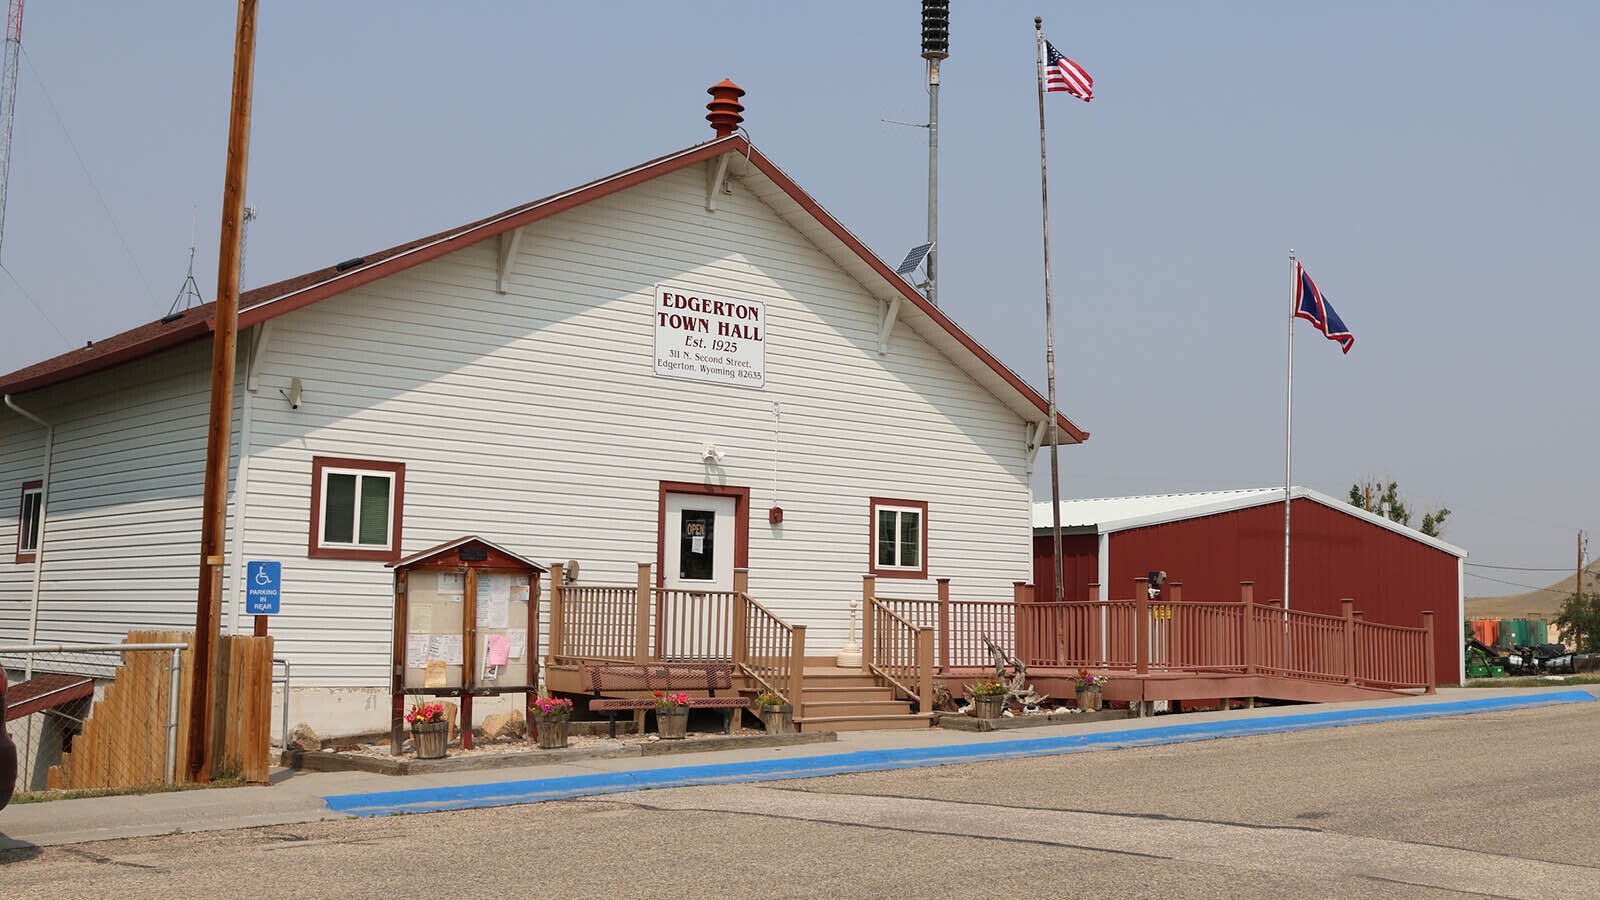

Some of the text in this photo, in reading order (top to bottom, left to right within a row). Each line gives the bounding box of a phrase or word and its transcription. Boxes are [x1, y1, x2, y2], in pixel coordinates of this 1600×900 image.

[663, 292, 759, 321] EDGERTON
[658, 312, 762, 341] TOWN HALL
[685, 336, 737, 352] Est. 1925
[669, 350, 680, 358] 311
[684, 352, 692, 360] N.
[695, 353, 722, 364] Second
[700, 365, 735, 378] Wyoming
[738, 370, 762, 380] 82635
[687, 524, 704, 535] OPEN
